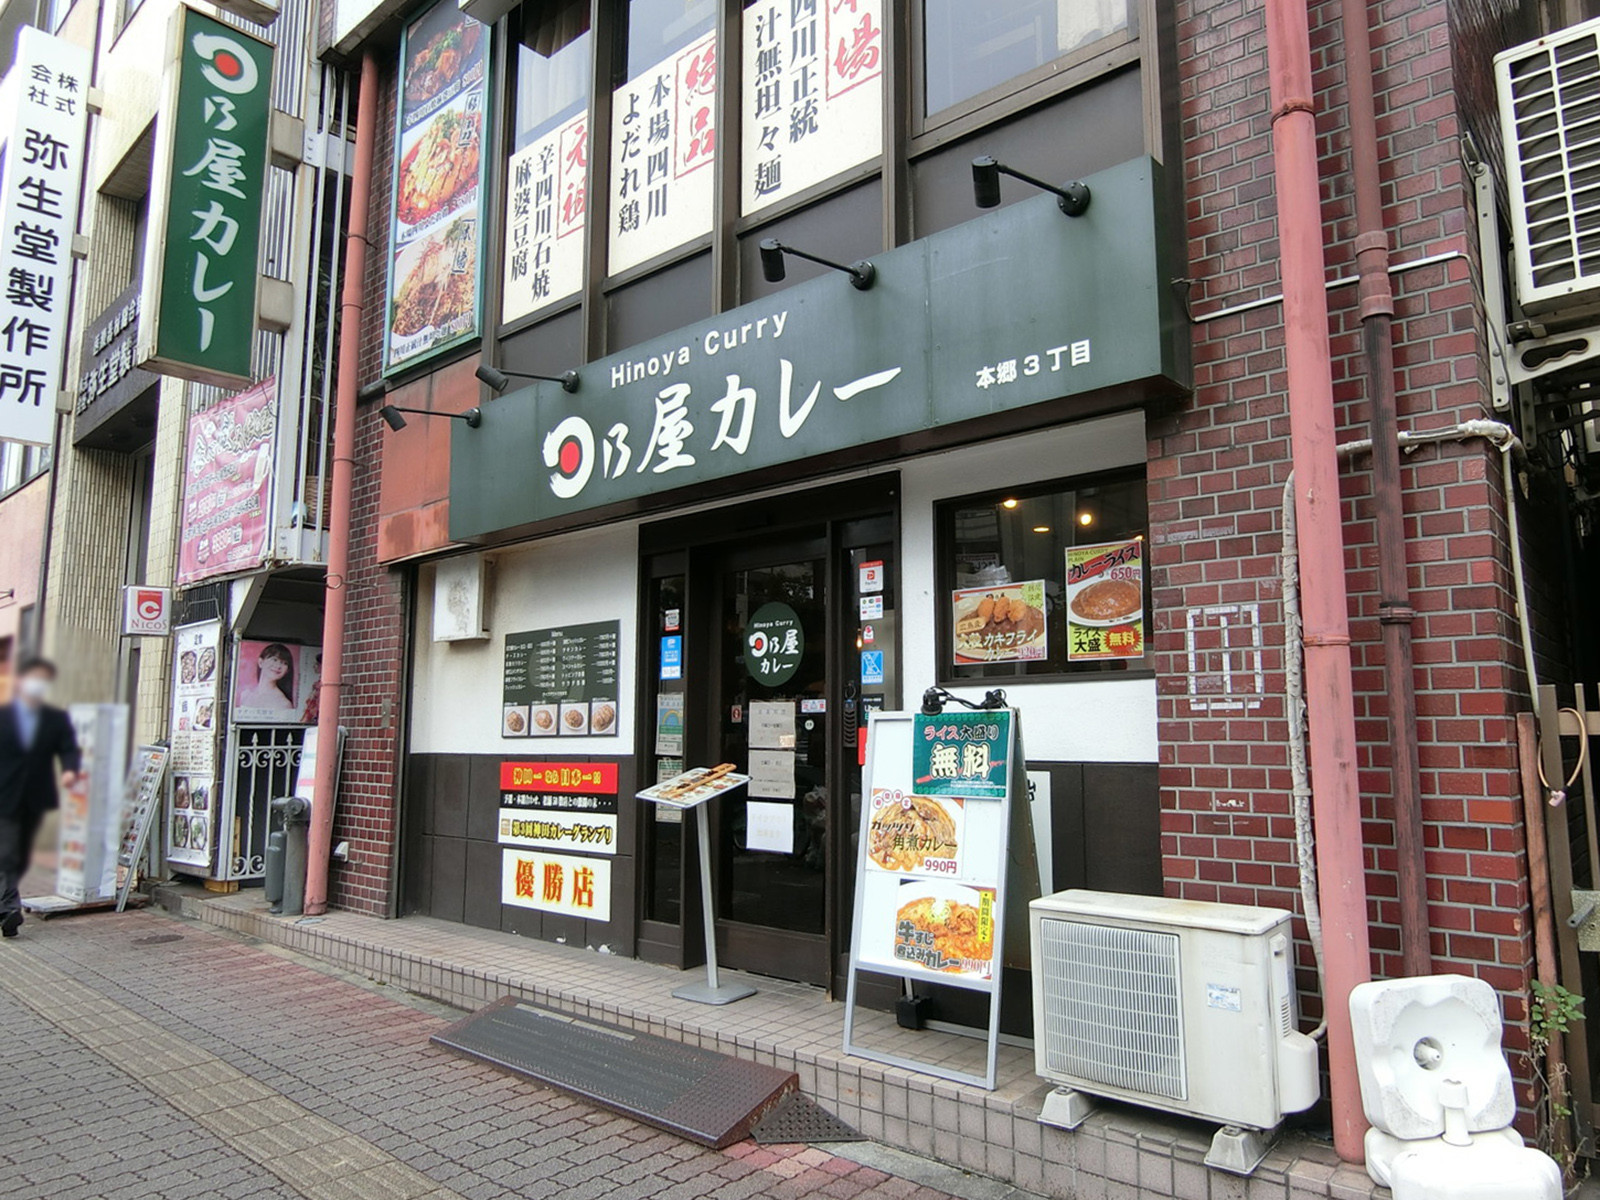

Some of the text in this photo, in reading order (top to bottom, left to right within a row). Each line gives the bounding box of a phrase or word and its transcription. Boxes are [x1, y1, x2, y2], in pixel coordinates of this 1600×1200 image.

[28, 64, 53, 107] 会社
[54, 72, 79, 116] 株式
[645, 73, 671, 226] 本場四川
[618, 93, 641, 237] よだれ鶏
[510, 157, 532, 283] 麻婆豆腐
[0, 127, 70, 406] 弥生堂製作所
[610, 310, 788, 389] Hinoya Curry
[1069, 546, 1139, 579] カレーライス
[1110, 566, 1141, 581] 650円
[1073, 627, 1101, 638] ライス
[1074, 639, 1101, 652] 大盛
[1109, 631, 1135, 647] 無料
[760, 657, 793, 674] カレー
[924, 724, 999, 741] ライス大盛り
[931, 743, 990, 778] 無料
[872, 821, 915, 832] ガッツリ
[893, 833, 957, 851] 角煮カレー
[925, 860, 957, 874] 990円
[515, 858, 594, 908] 優勝店
[897, 920, 934, 945] 牛すじ
